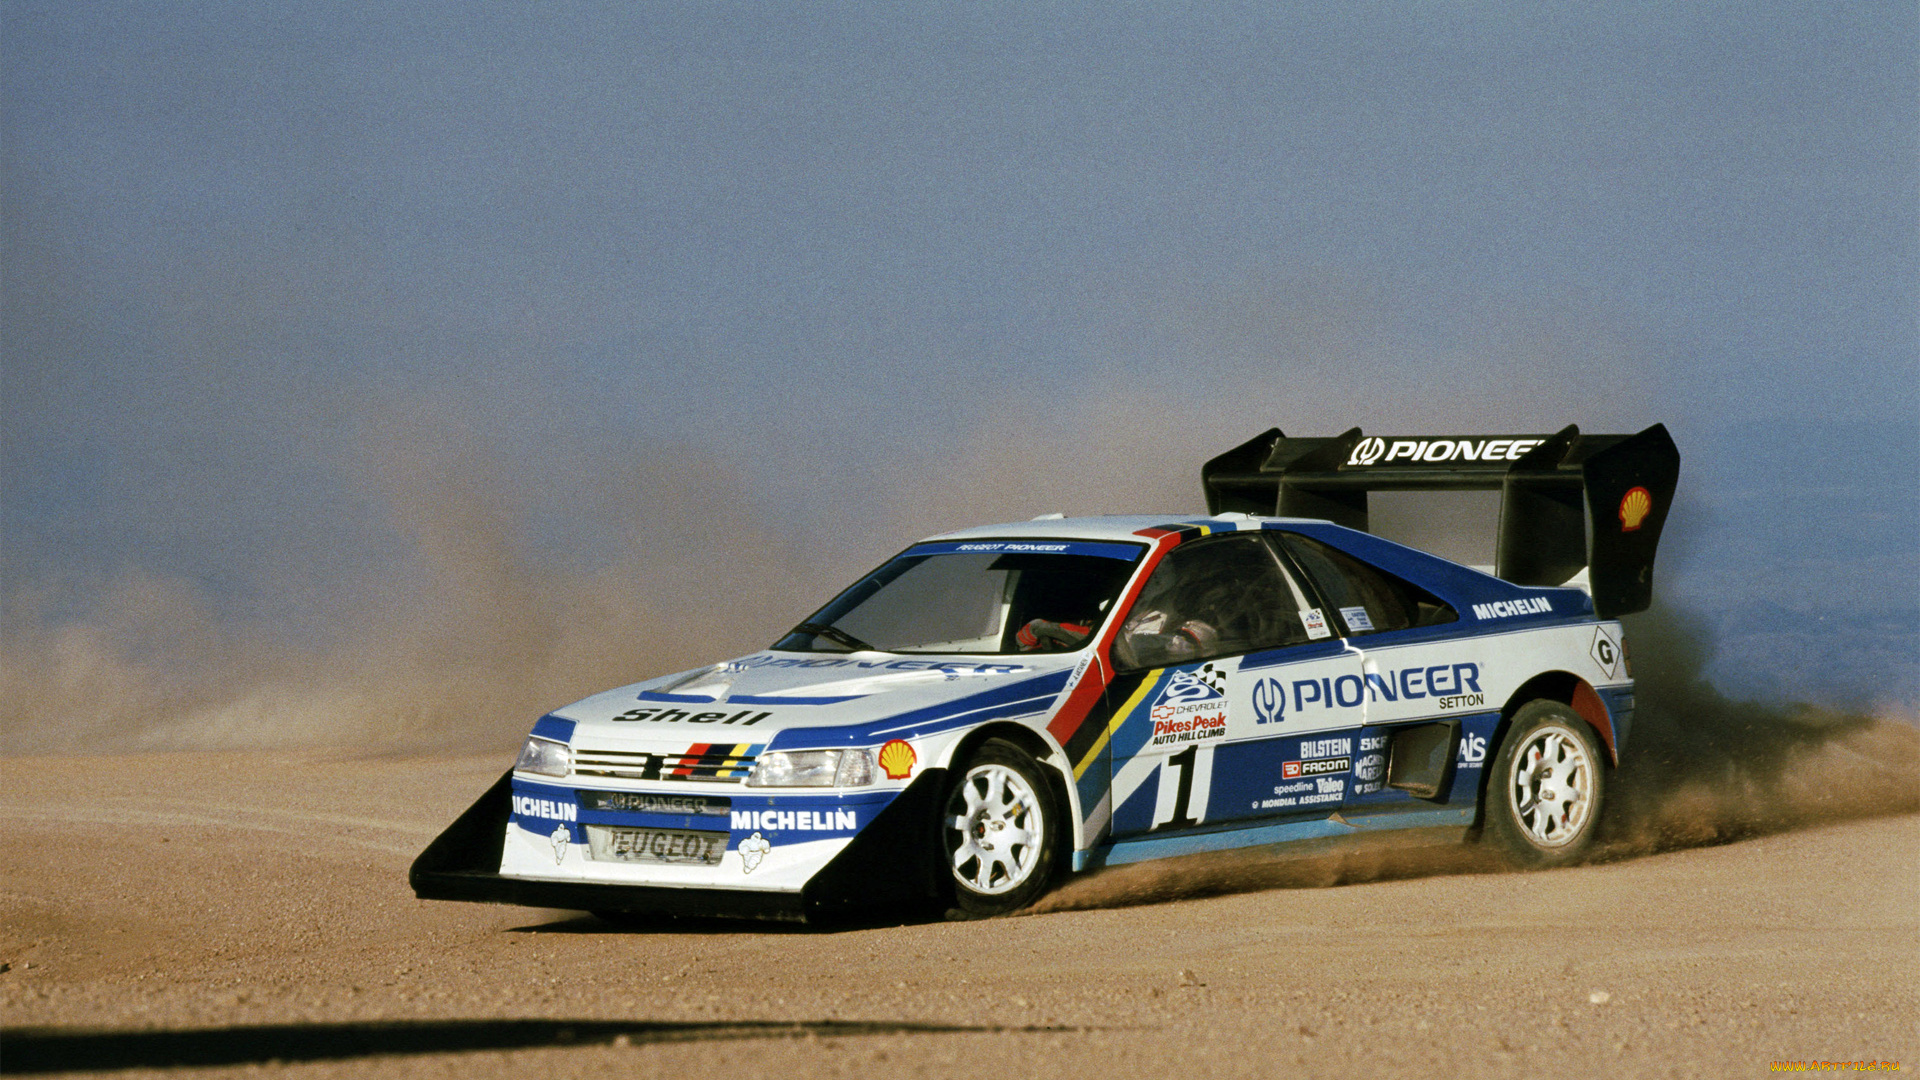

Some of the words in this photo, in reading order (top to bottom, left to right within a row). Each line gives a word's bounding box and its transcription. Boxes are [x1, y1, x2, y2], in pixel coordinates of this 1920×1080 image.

[1385, 440, 1546, 462] PIONEE
[1472, 597, 1553, 620] MICHELIN
[1598, 640, 1613, 665] G
[1292, 662, 1482, 712] PIONEER
[1176, 701, 1228, 714] CHEVROLET
[1439, 694, 1484, 709] SETTON
[612, 709, 774, 726] Shell
[1154, 719, 1192, 736] Pikes
[1192, 712, 1227, 730] Peak
[1152, 734, 1177, 745] AUTO
[1178, 731, 1196, 742] HILL
[1197, 727, 1226, 740] CLIMB
[1300, 738, 1351, 759] BILSTEIN
[1302, 759, 1349, 773] FACOM
[1156, 745, 1199, 831] 1
[1274, 782, 1314, 796] speedline
[1316, 777, 1344, 793] Valeo
[1262, 797, 1297, 808] MONDIAL
[1299, 793, 1343, 804] ASSISTANCE
[731, 811, 857, 831] MICHELIN
